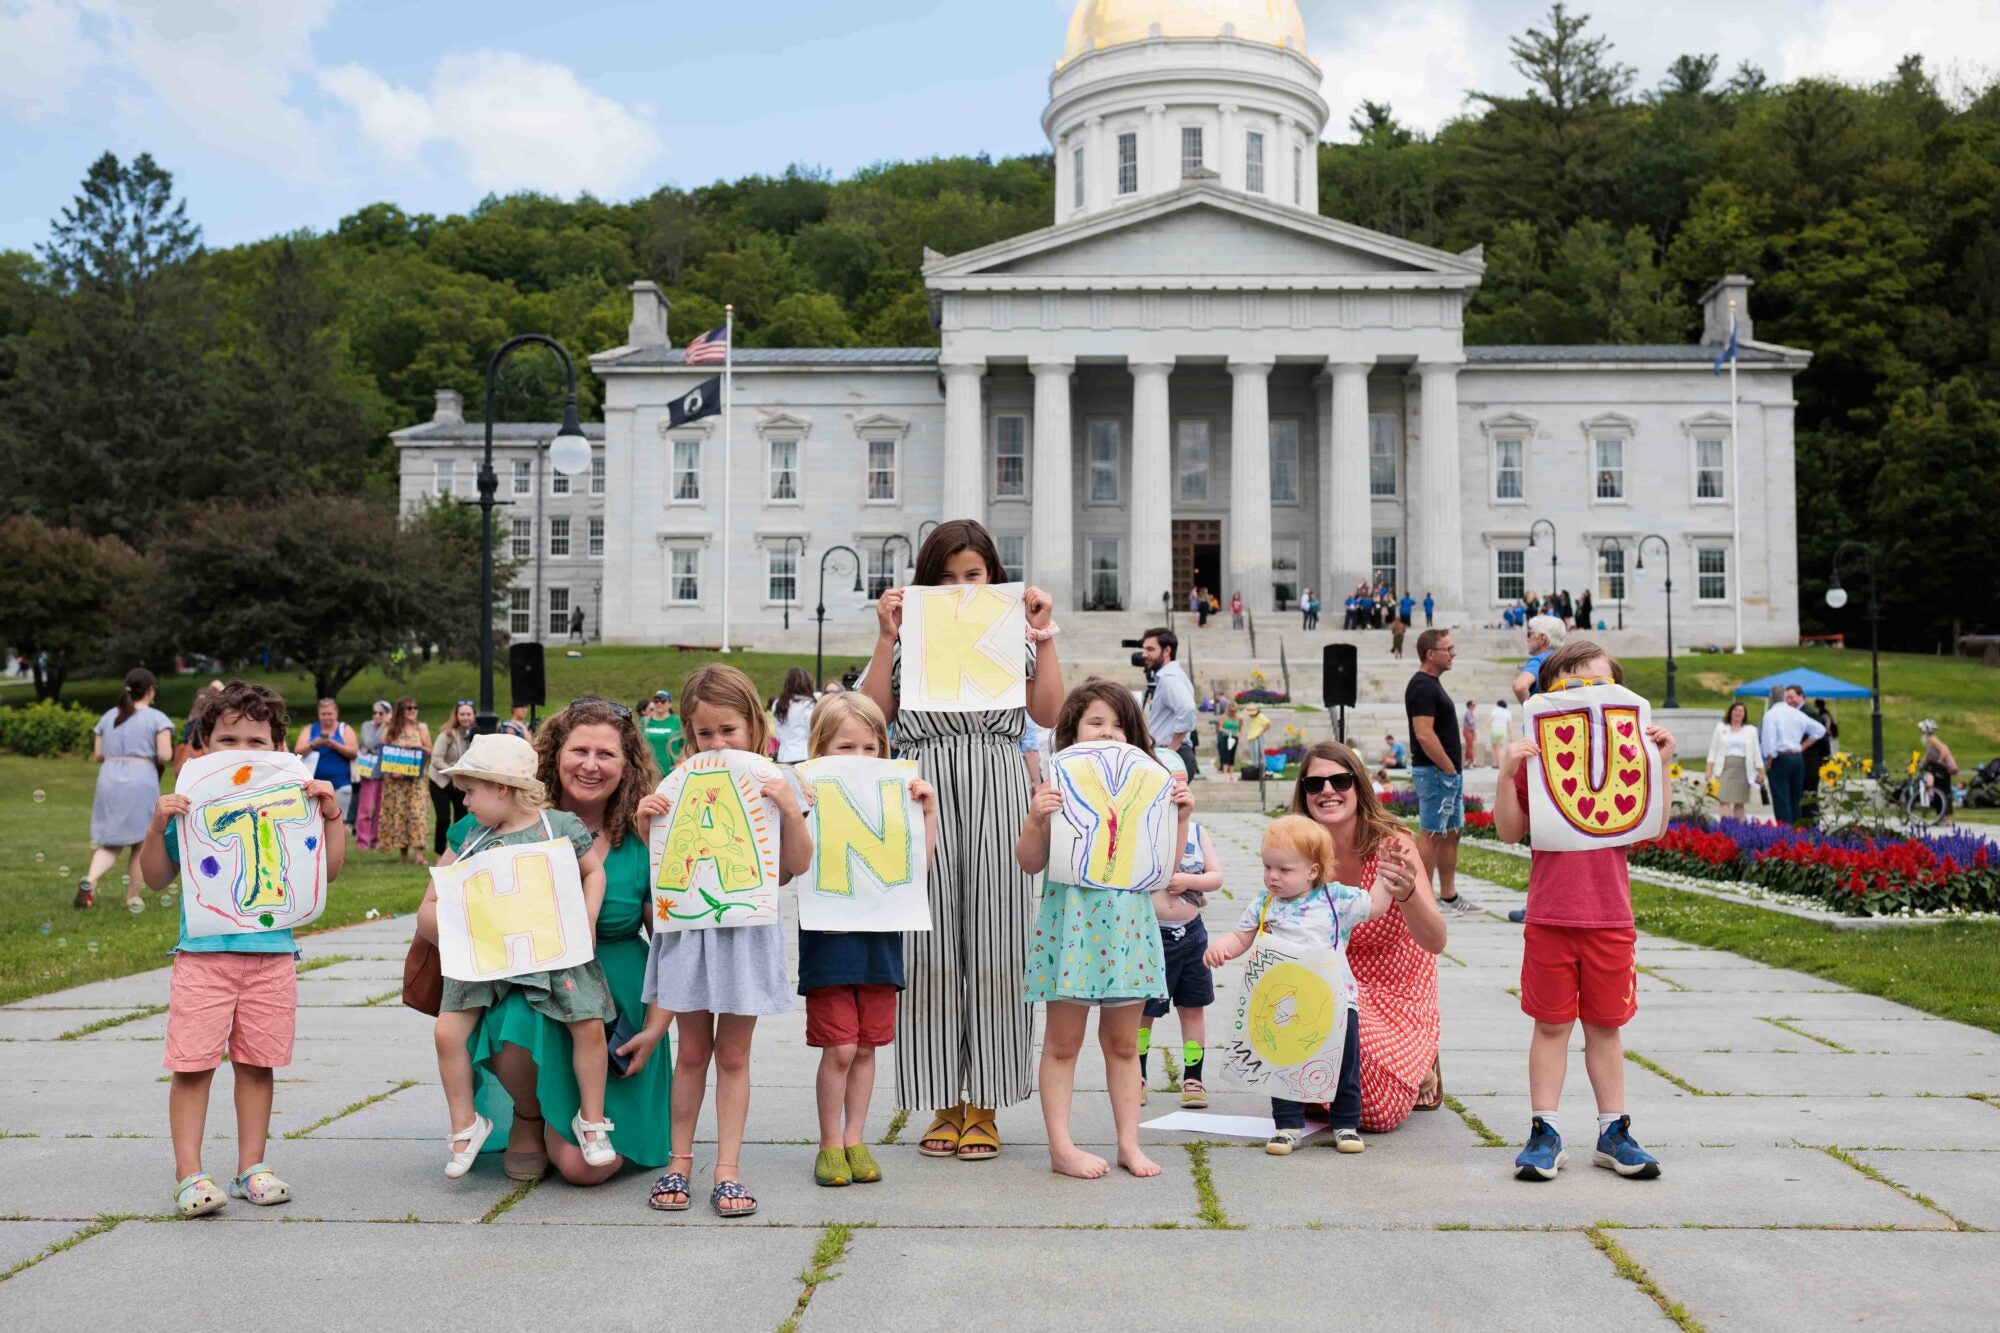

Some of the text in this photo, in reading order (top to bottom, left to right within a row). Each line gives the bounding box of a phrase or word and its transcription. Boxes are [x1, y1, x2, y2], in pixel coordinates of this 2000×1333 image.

[920, 585, 1022, 703] K
[656, 770, 763, 893] A
[1060, 756, 1172, 891] Y
[1533, 704, 1651, 838] U
[203, 783, 309, 910] T
[813, 776, 913, 899] N
[463, 852, 566, 976] H
[1248, 961, 1334, 1068] O
